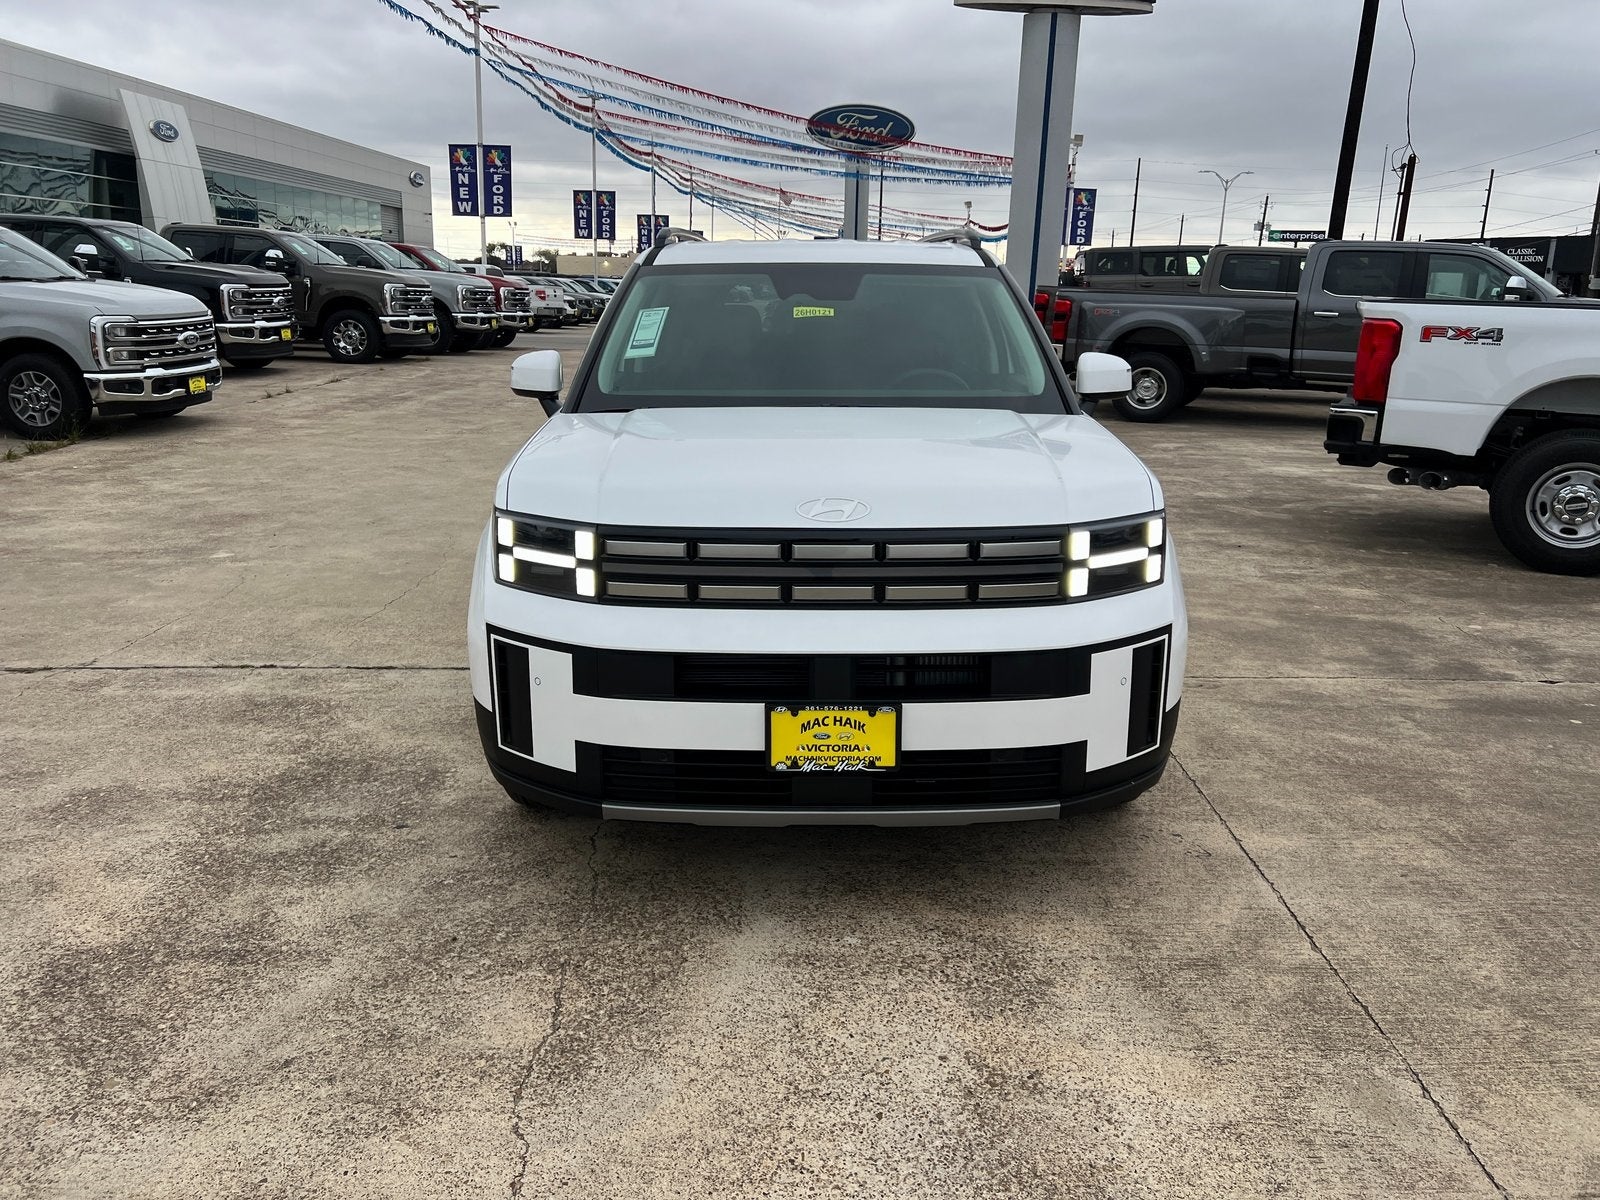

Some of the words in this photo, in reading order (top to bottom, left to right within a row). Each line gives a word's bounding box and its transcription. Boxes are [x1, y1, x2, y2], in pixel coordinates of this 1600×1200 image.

[830, 112, 894, 142] Ford
[457, 173, 472, 213] NEW
[492, 174, 504, 215] FORD
[578, 209, 588, 237] NEW
[602, 210, 610, 238] FORD
[1076, 211, 1087, 244] FORD
[641, 229, 649, 251] NEW
[1269, 232, 1325, 241] enterprise
[1509, 255, 1544, 263] OLLISION
[1419, 325, 1504, 343] FX4
[800, 716, 829, 734] MAC
[833, 716, 866, 734] HAIK
[806, 744, 861, 752] VICTORIA
[800, 760, 832, 772] Mac
[834, 760, 868, 772] Haik
